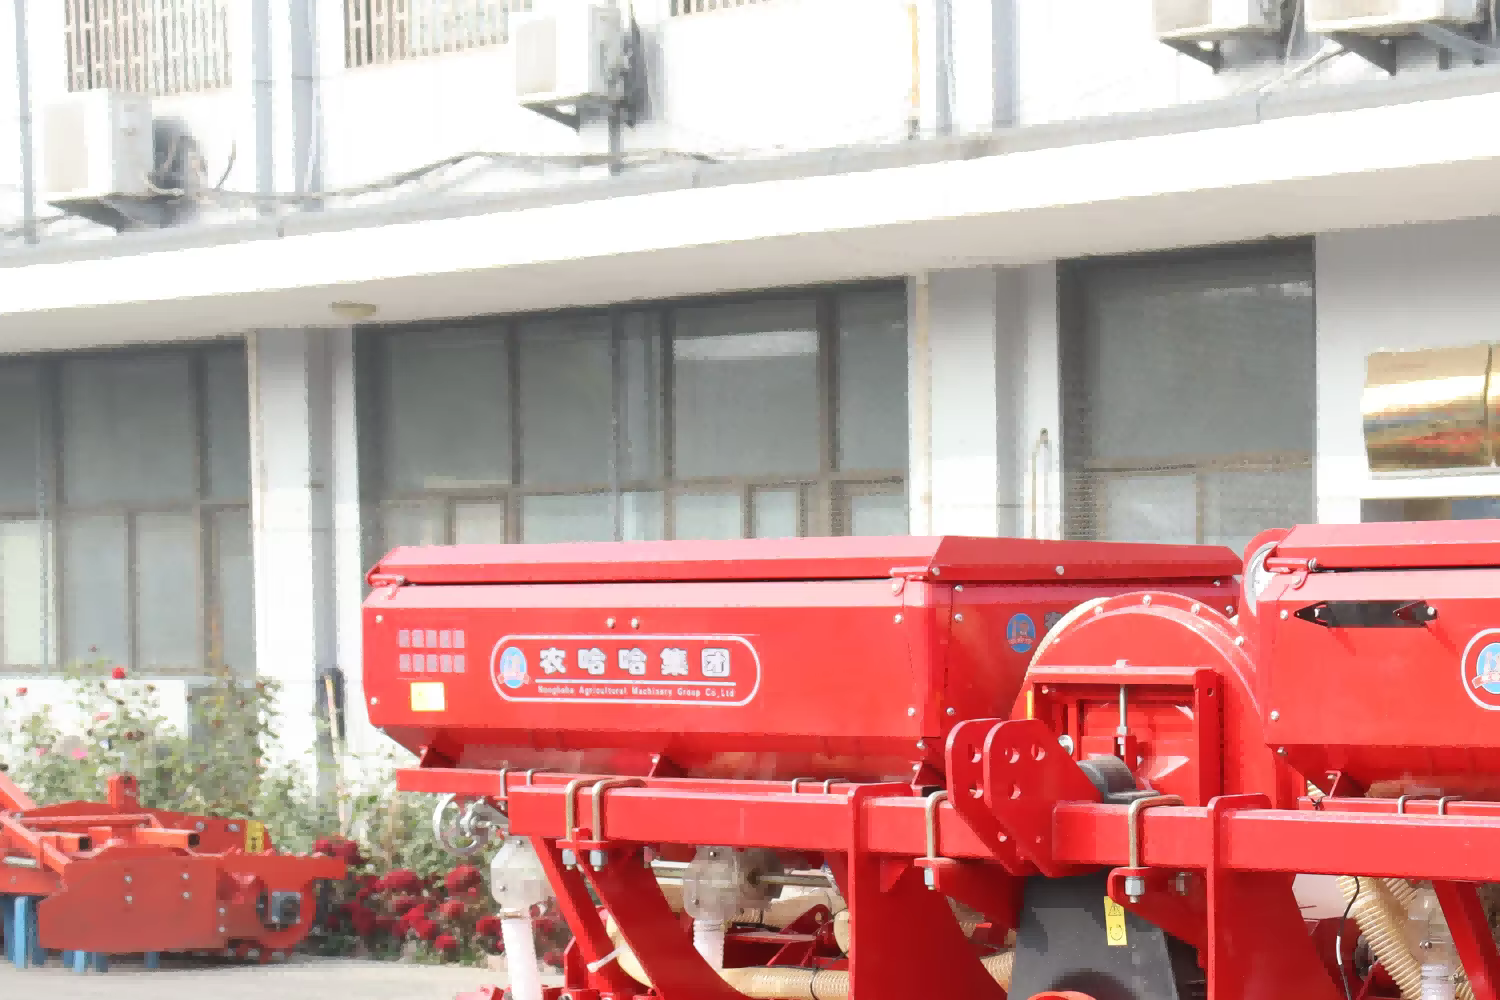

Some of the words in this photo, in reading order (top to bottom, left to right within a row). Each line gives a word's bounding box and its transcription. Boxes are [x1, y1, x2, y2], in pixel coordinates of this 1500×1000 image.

[539, 647, 731, 678] 农哈哈集团
[578, 686, 627, 697] Agricultural
[631, 686, 673, 697] Machinery
[677, 687, 701, 698] Group
